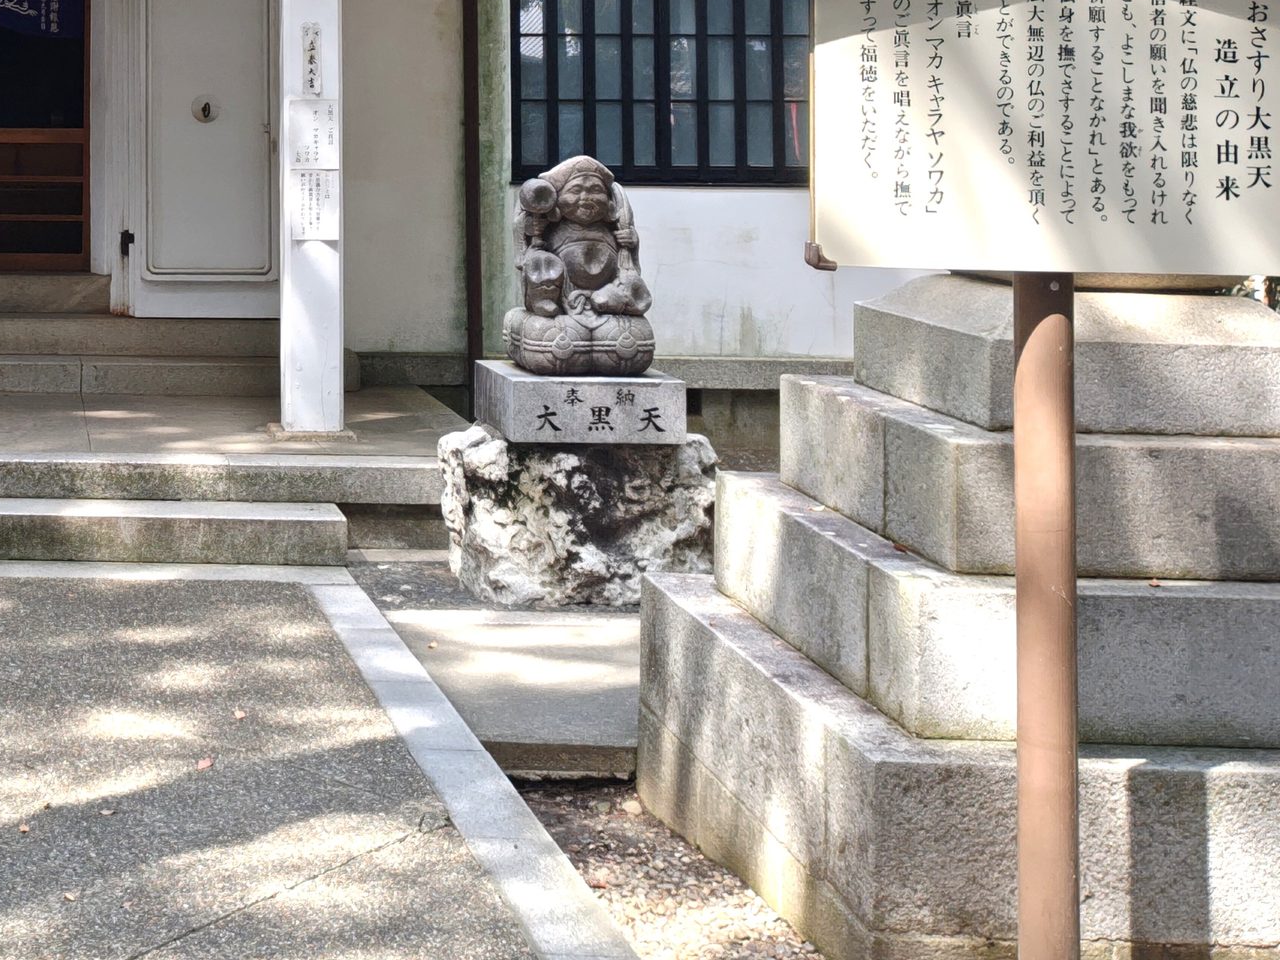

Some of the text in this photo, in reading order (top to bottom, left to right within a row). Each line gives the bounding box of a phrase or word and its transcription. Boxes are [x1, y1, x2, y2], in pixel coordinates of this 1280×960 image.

[1215, 39, 1240, 201] 造立の由来
[1247, 1, 1271, 188] おさすり大黒天
[536, 405, 665, 432] 大黒天
[564, 388, 635, 407] 奉納
